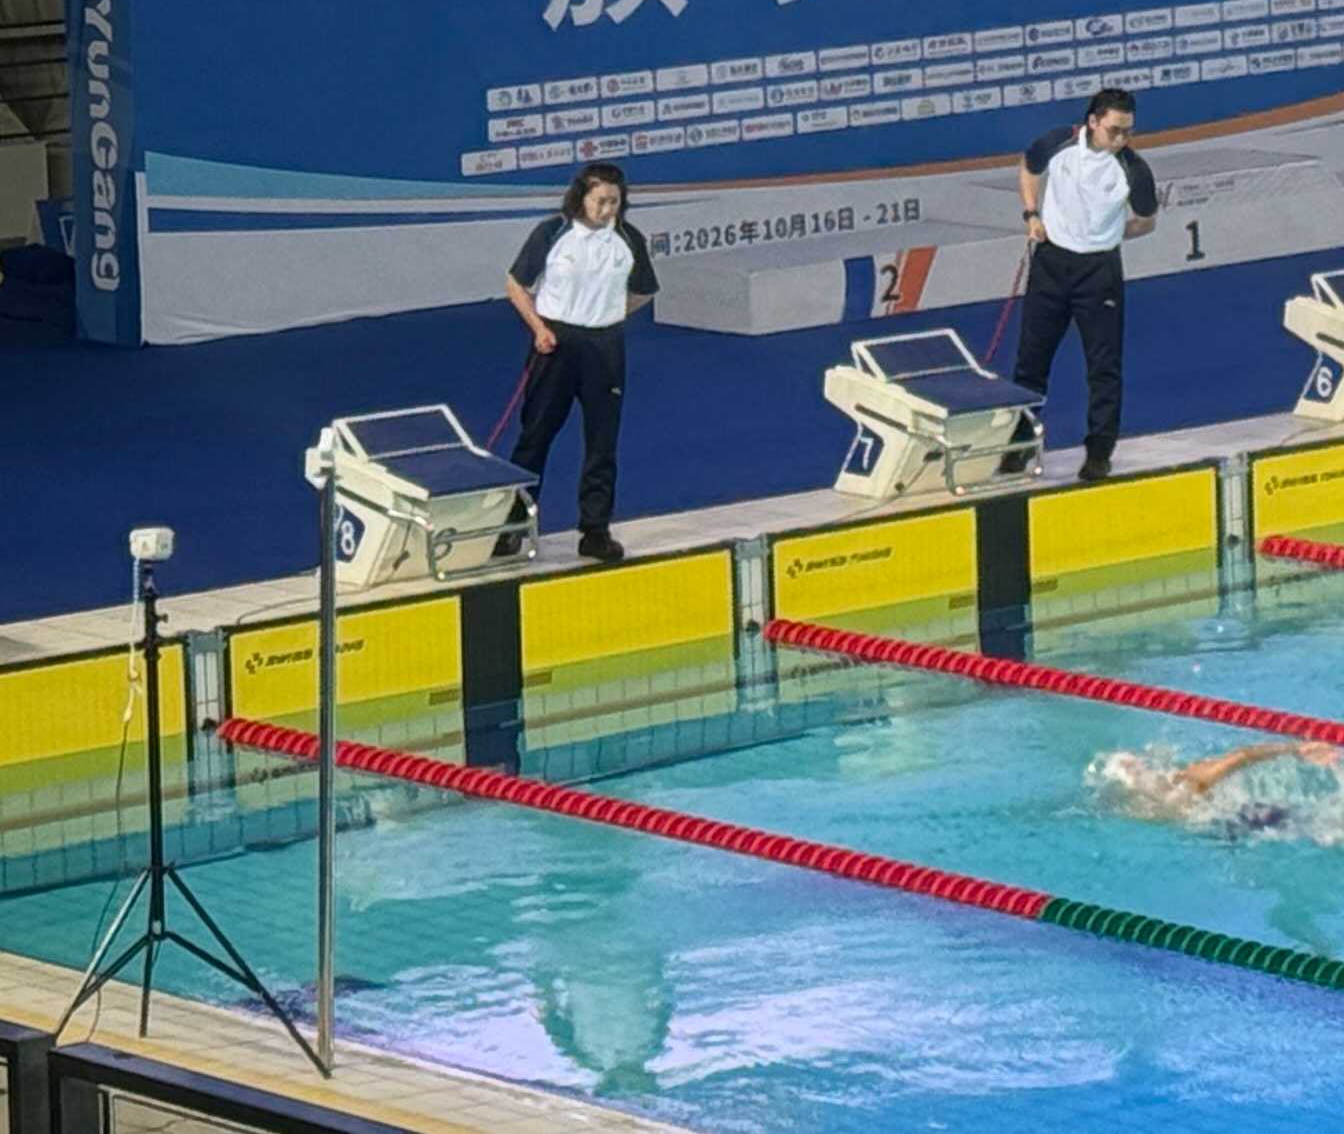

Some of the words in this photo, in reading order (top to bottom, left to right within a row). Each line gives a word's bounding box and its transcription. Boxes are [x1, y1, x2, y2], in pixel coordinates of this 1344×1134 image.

[1186, 222, 1206, 261] 1
[881, 264, 901, 302] 2
[1317, 366, 1333, 397] 6
[860, 437, 874, 471] 7
[341, 520, 355, 556] 8
